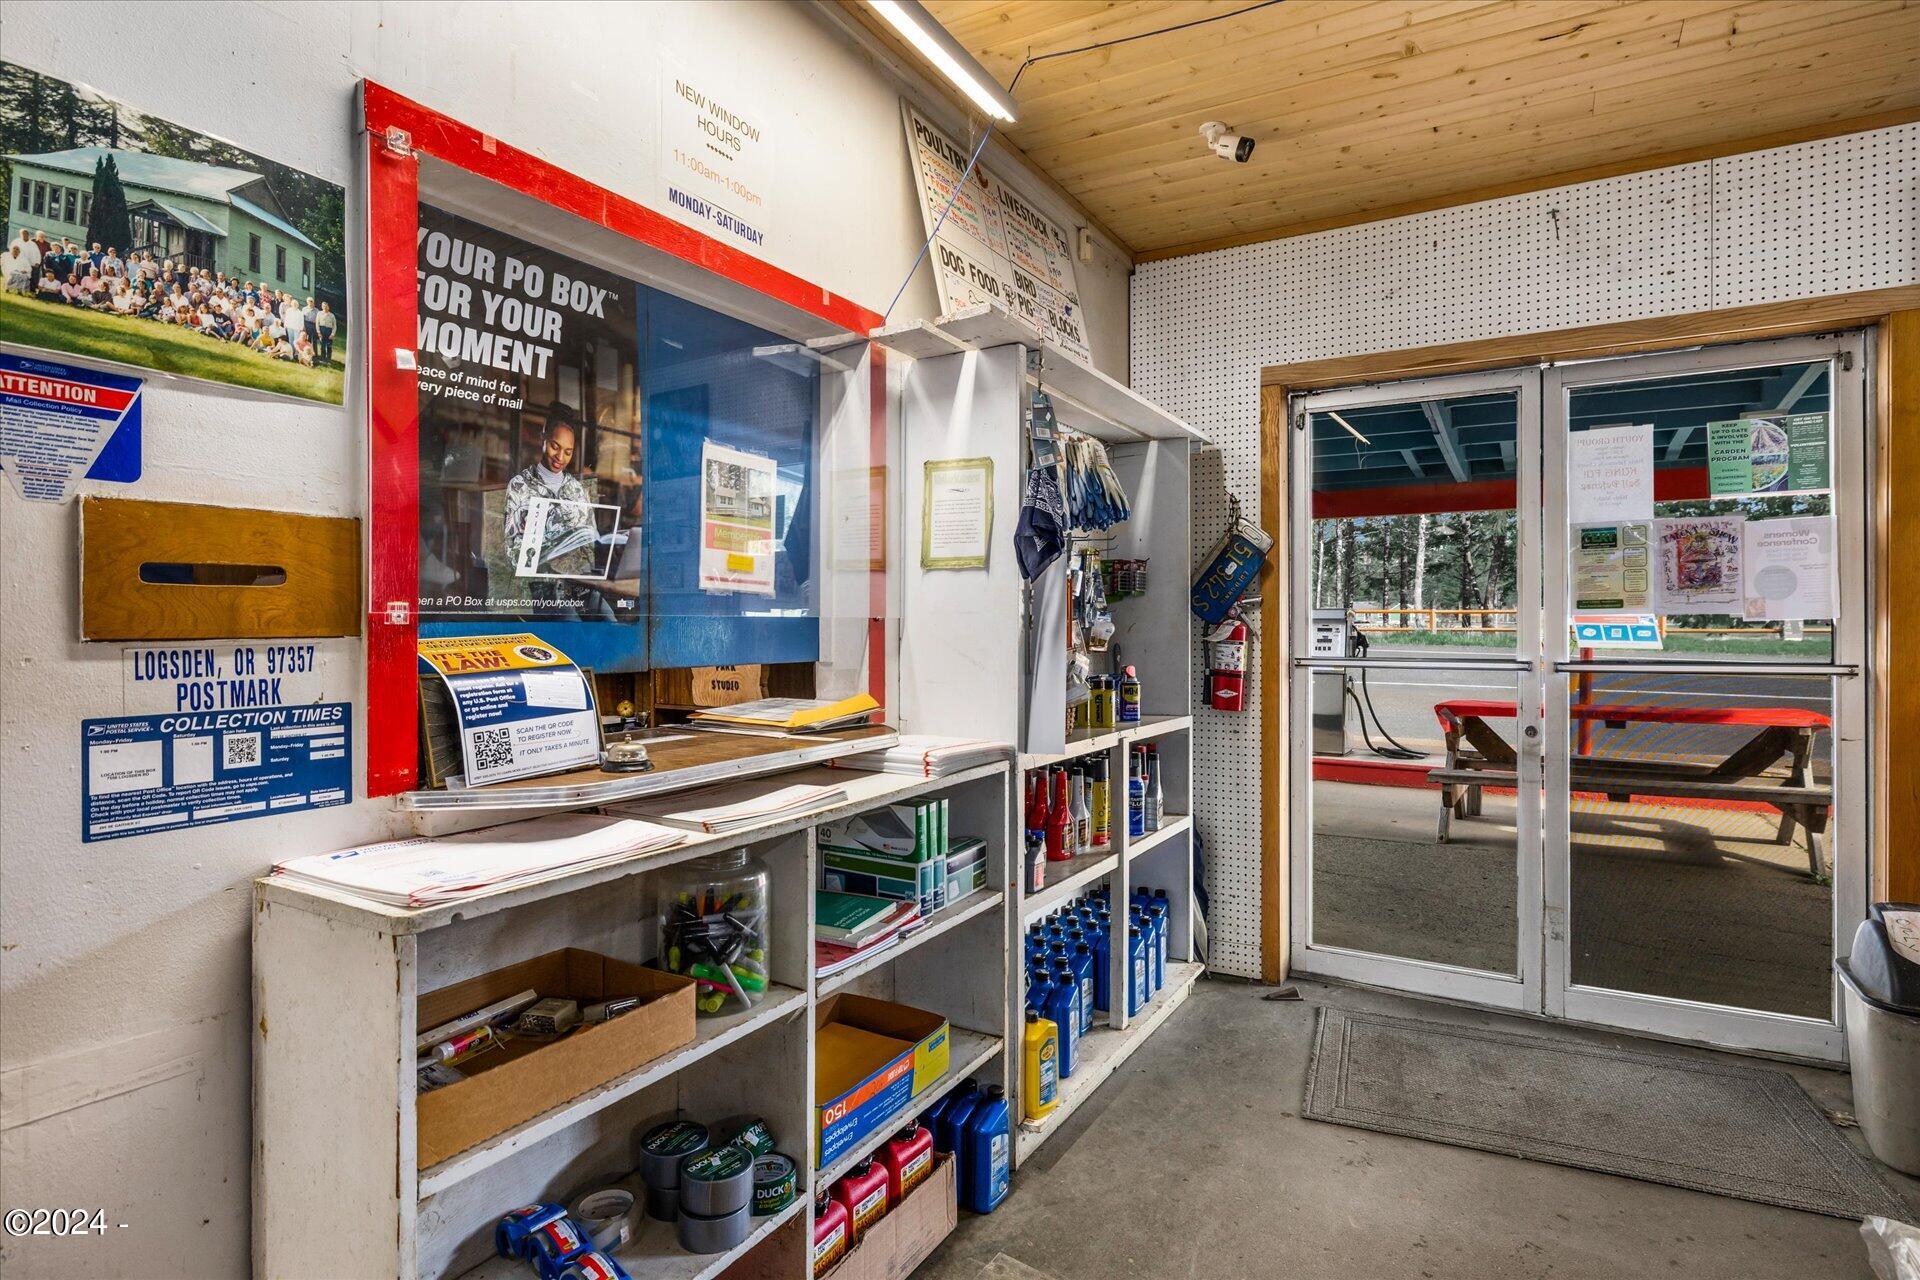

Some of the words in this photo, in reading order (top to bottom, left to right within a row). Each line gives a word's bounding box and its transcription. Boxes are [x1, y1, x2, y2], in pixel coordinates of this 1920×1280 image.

[676, 80, 706, 109] NEW
[709, 100, 760, 142] WINDOW
[698, 114, 741, 151] HOURS
[914, 118, 969, 176] POULTRY
[669, 187, 764, 246] MONDAY-SATURDAY
[997, 184, 1049, 239] LIVESTOCK
[503, 256, 544, 298] PO
[940, 244, 965, 276] DOG
[969, 262, 1000, 297] FOOD
[1014, 270, 1037, 298] BIRD
[482, 290, 563, 344] YOUR
[1018, 292, 1034, 317] PIG
[1048, 309, 1081, 343] BLOCKS
[418, 314, 554, 380] MOMENT
[418, 365, 446, 380] eace
[450, 372, 463, 383] of
[466, 374, 497, 390] mind
[500, 382, 517, 394] for
[23, 400, 60, 409] Collection
[62, 405, 83, 415] Policy
[418, 380, 442, 396] very
[444, 384, 480, 403] piece
[483, 392, 496, 404] of
[498, 395, 523, 411] mail
[445, 596, 462, 606] PO
[464, 596, 483, 607] Box
[485, 598, 494, 607] at
[497, 597, 585, 609] usps.com/yourpobox
[134, 648, 222, 681] LOGSDEN,
[234, 648, 255, 676] OR
[268, 646, 315, 674] 97357
[431, 652, 465, 661] IT'S
[468, 650, 503, 658] THE
[441, 658, 511, 672] LAW!
[176, 678, 282, 712] POSTMARK
[712, 680, 740, 691] STUDIO
[160, 710, 287, 733] COLLECTION
[292, 706, 343, 723] TIMES
[516, 726, 534, 735] SCAN
[548, 722, 557, 730] QR
[558, 720, 574, 728] CODE
[527, 746, 544, 755] ONLY
[569, 739, 590, 747] MINUTE
[528, 731, 556, 741] REGISTER
[820, 828, 832, 839] 40
[825, 1101, 847, 1124] 150
[752, 1122, 767, 1136] TAP
[648, 1136, 668, 1150] DUCK
[688, 1158, 708, 1173] DUCK
[757, 1185, 784, 1199] DUCK
